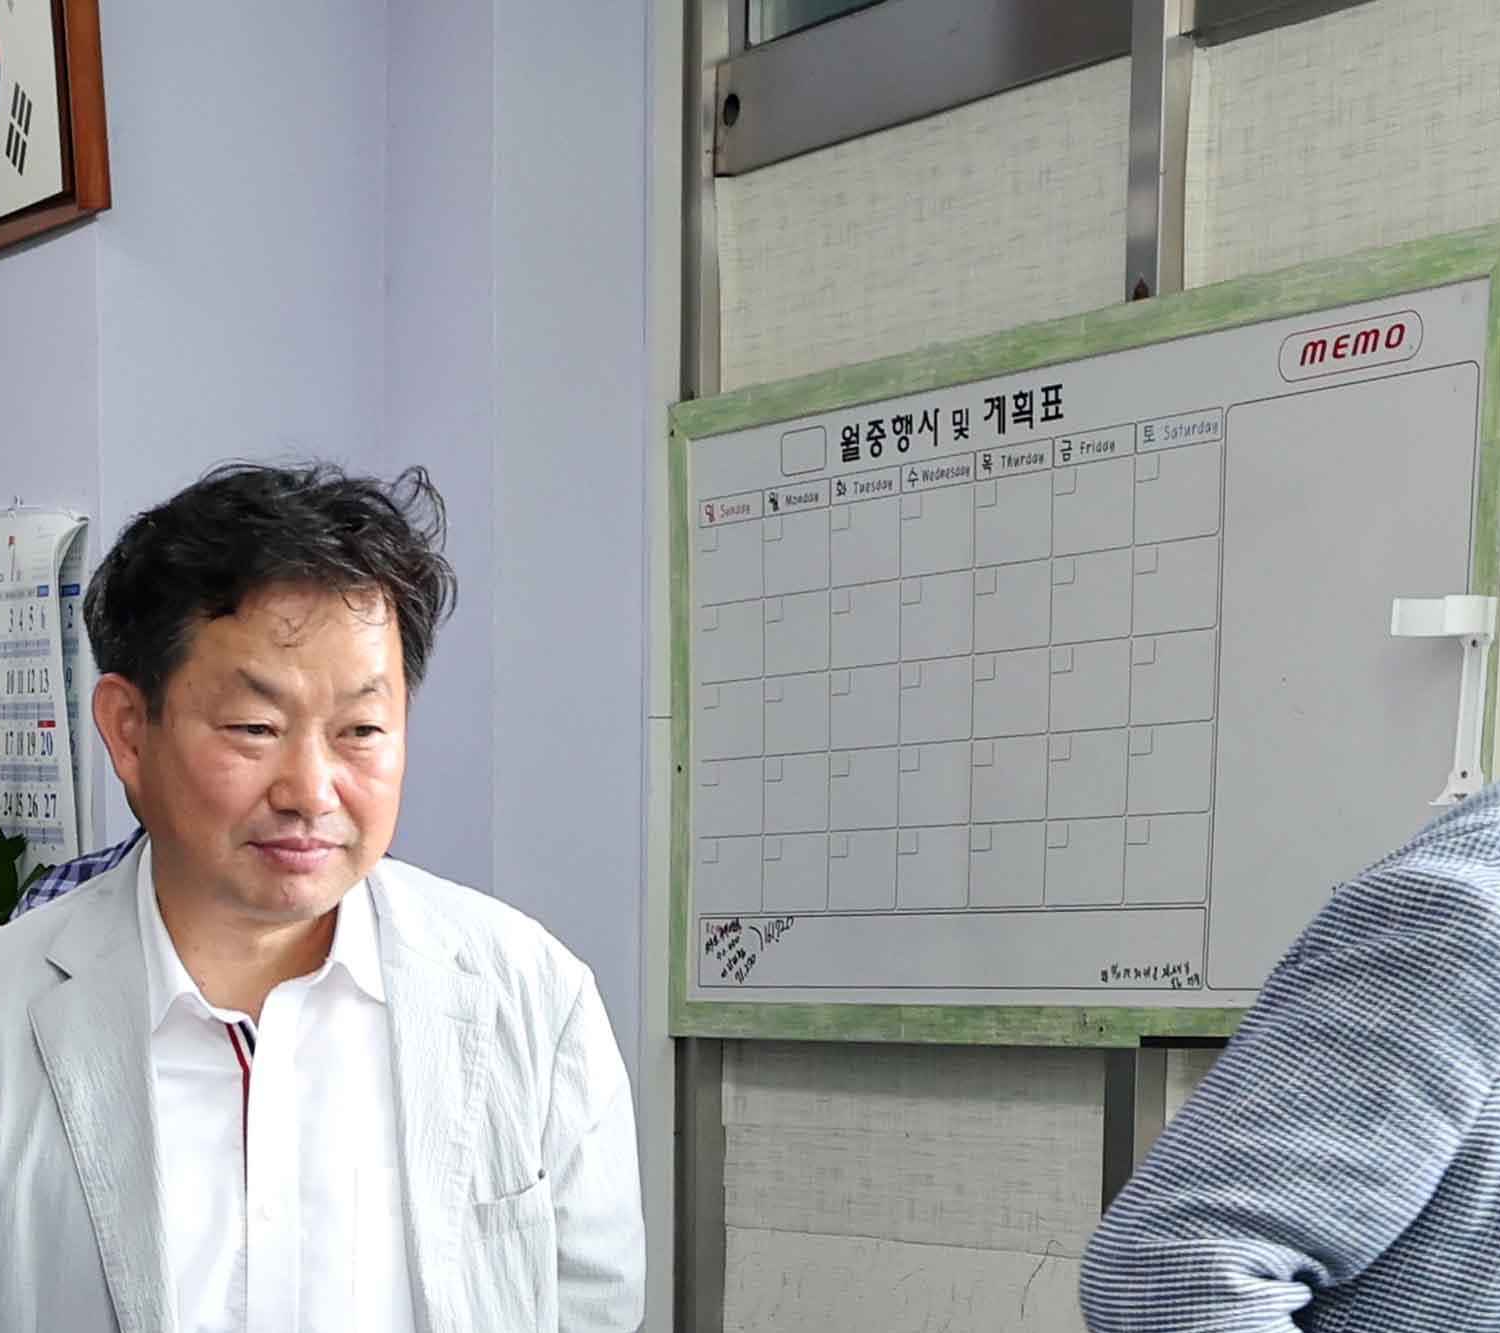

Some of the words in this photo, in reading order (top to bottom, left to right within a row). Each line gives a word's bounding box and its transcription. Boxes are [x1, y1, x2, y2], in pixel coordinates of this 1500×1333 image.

[1300, 323, 1405, 367] MEMO
[840, 408, 939, 463] 월중행사
[952, 408, 970, 440] 및
[983, 384, 1064, 435] 계획표
[1163, 420, 1219, 441] Saturday
[1061, 440, 1073, 463] 금
[1080, 440, 1115, 455] Friday
[982, 454, 993, 475] 목
[907, 469, 918, 488] 수
[922, 465, 970, 482] Wednesday
[785, 492, 819, 505] Monday
[836, 479, 846, 497] 화
[853, 479, 893, 495] Tuesday
